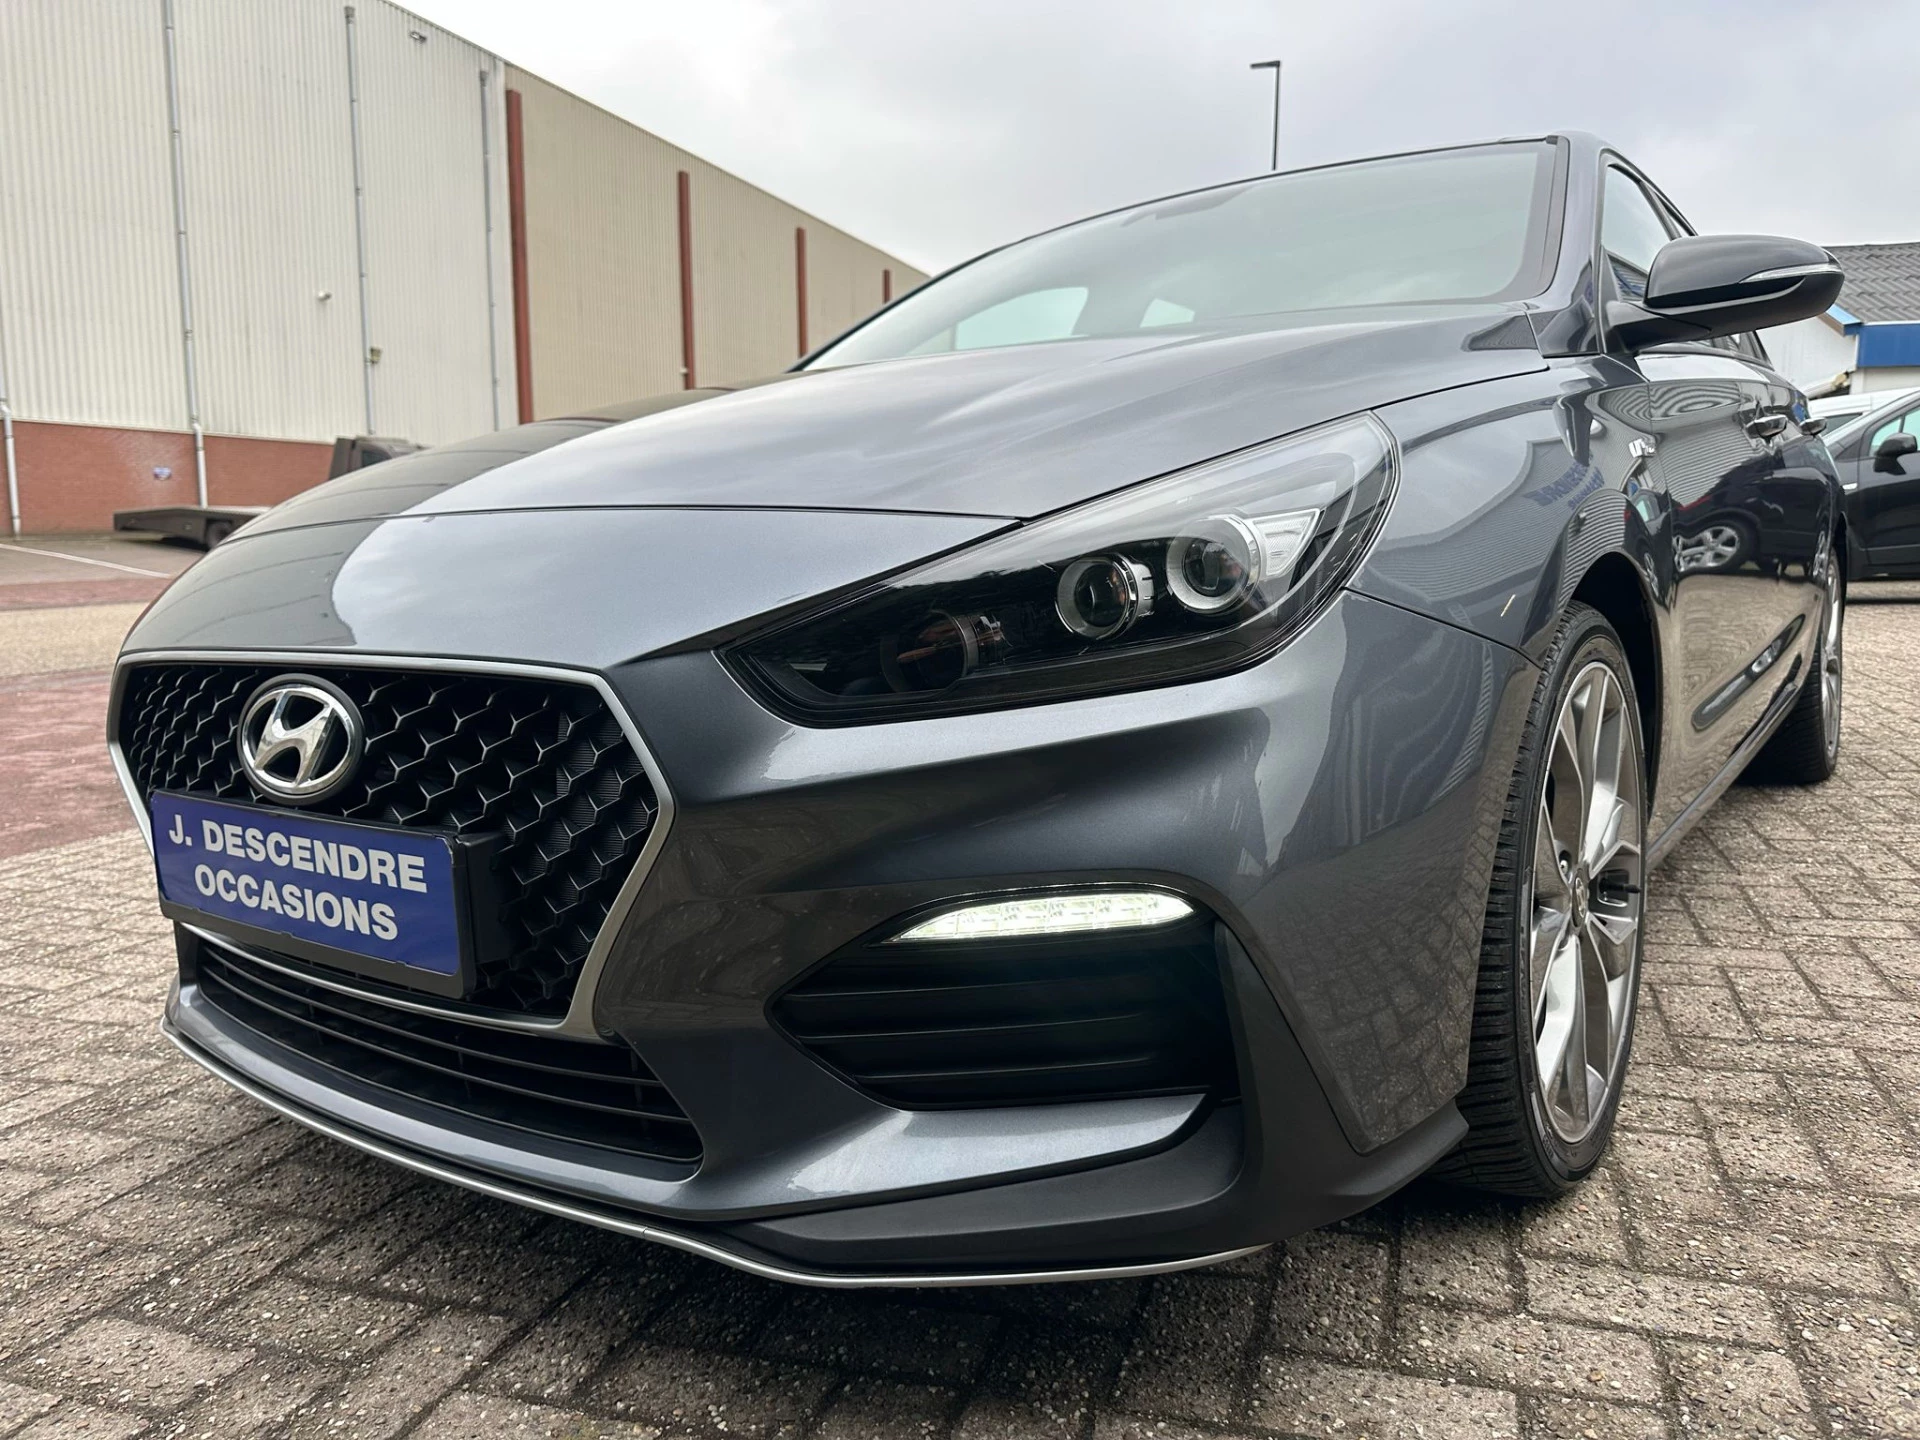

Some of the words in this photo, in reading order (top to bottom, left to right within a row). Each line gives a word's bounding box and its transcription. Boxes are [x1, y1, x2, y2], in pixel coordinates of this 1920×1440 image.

[168, 814, 193, 847] J.
[202, 820, 428, 893] DESCENDRE
[194, 864, 398, 941] OCCASIONS
